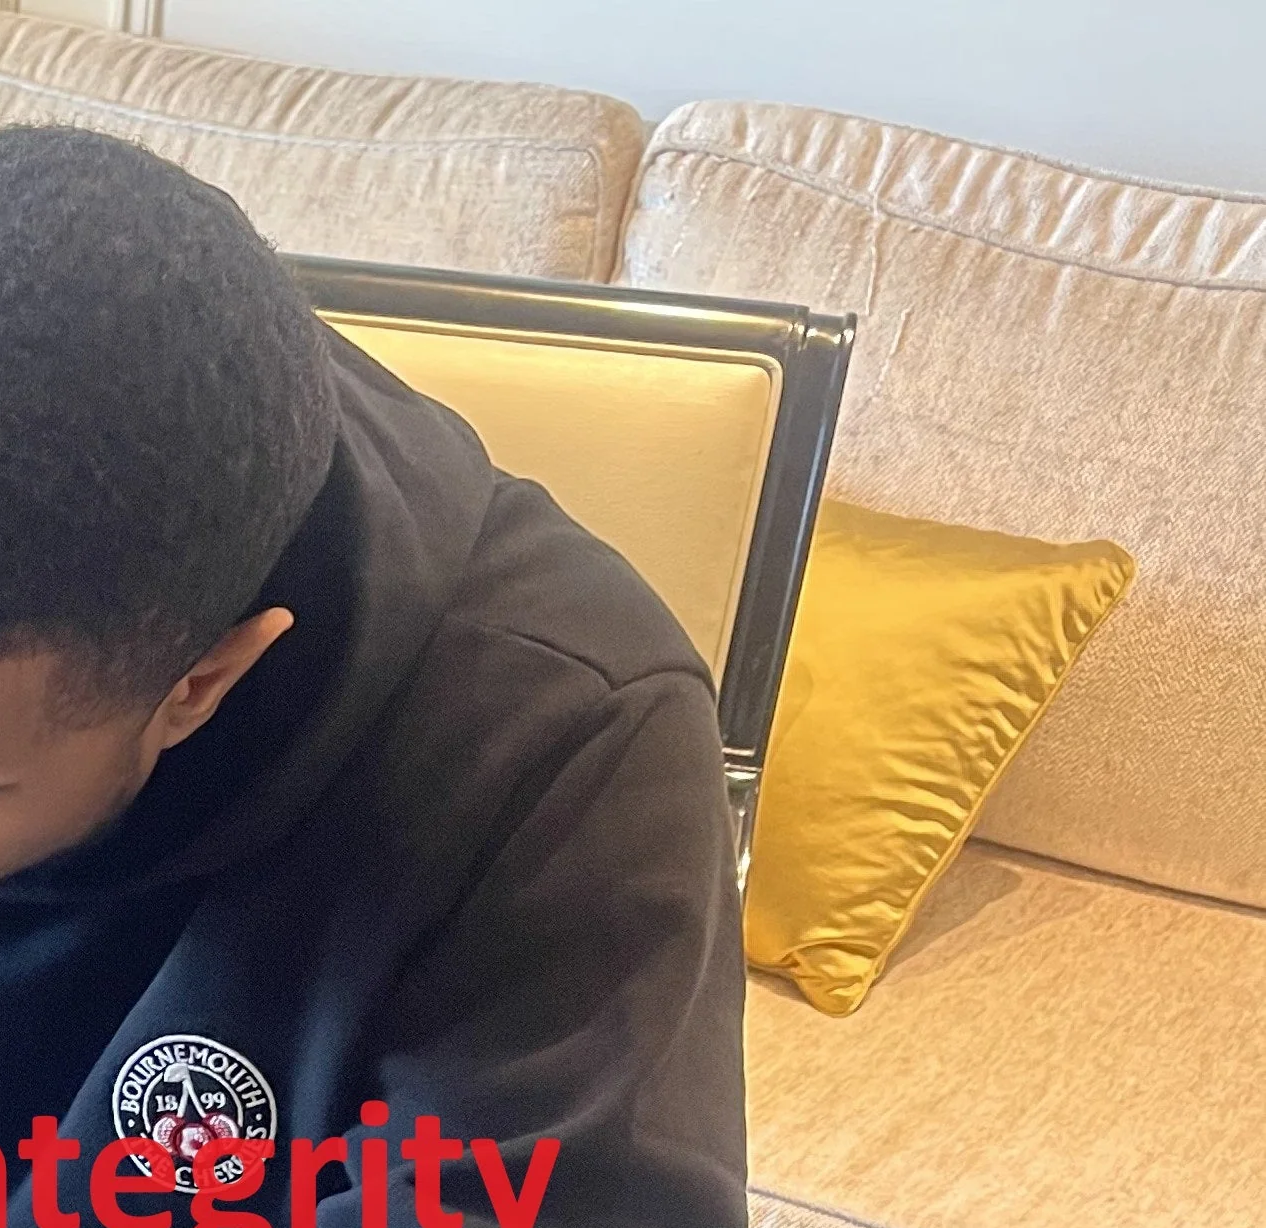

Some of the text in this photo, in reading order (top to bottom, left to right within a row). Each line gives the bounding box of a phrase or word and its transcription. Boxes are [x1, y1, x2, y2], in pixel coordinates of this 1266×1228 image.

[120, 1043, 266, 1115] BOURNEMOUTH
[155, 1091, 226, 1112] 18 99
